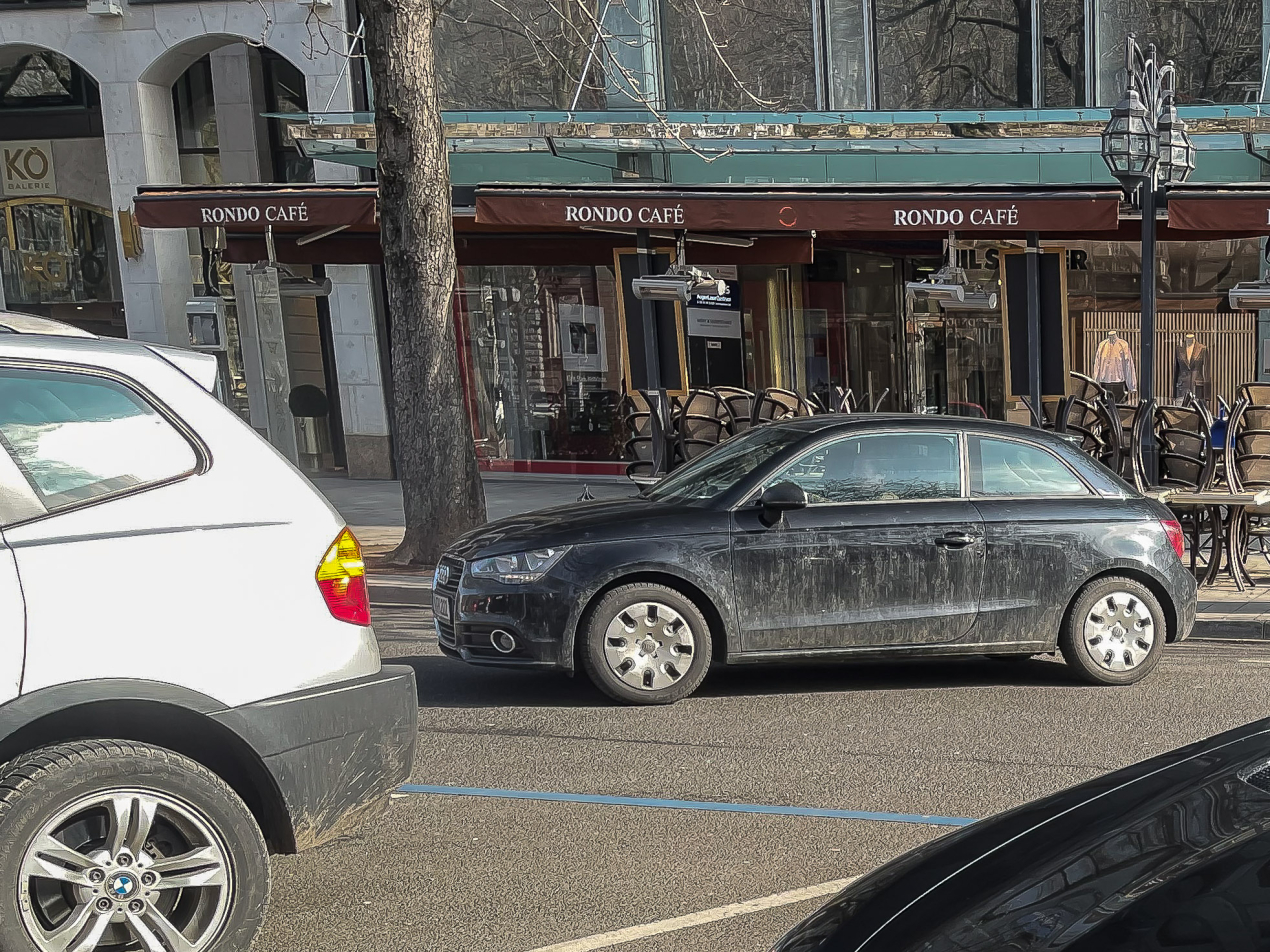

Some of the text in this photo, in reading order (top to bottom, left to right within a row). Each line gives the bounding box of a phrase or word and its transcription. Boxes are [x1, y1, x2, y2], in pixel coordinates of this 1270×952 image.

[201, 202, 309, 223] RONDO CAFÉ
[565, 204, 685, 224] RONDO CAFÉ
[893, 205, 1019, 226] RONDO CAFÉ
